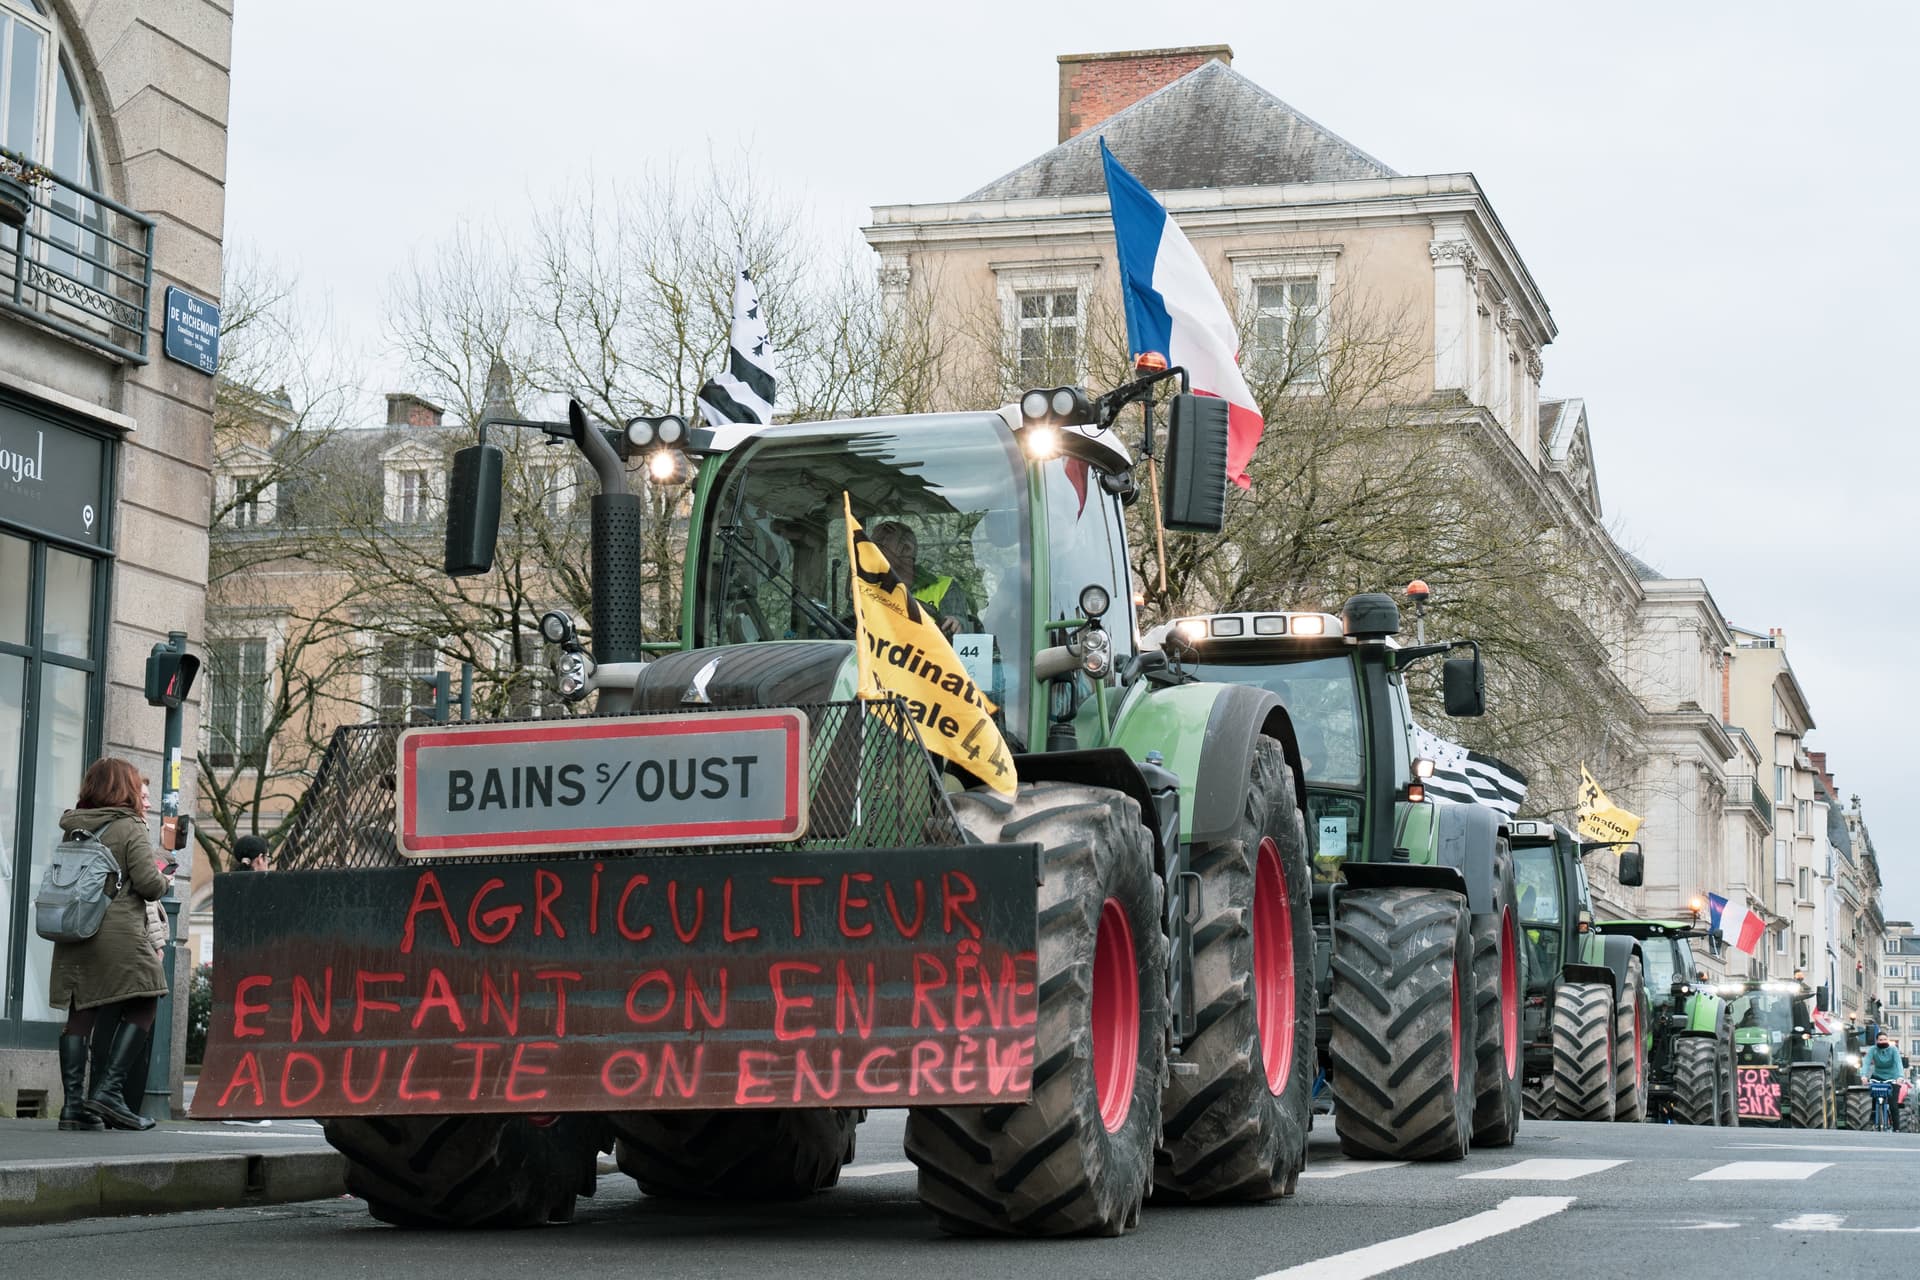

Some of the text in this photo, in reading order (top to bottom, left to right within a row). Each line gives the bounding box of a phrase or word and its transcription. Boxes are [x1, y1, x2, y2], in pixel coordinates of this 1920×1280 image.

[170, 306, 180, 321] DE
[182, 312, 217, 338] RICHEMONT
[0, 430, 44, 483] oyal
[960, 646, 980, 658] 44
[448, 764, 586, 813] BAINS
[1324, 825, 1338, 834] 44
[234, 938, 1038, 1043] ENFANT ON EN RÊVE
[216, 1042, 560, 1108] ADULTE
[601, 1043, 704, 1099] ON
[1737, 1068, 1770, 1085] TOP
